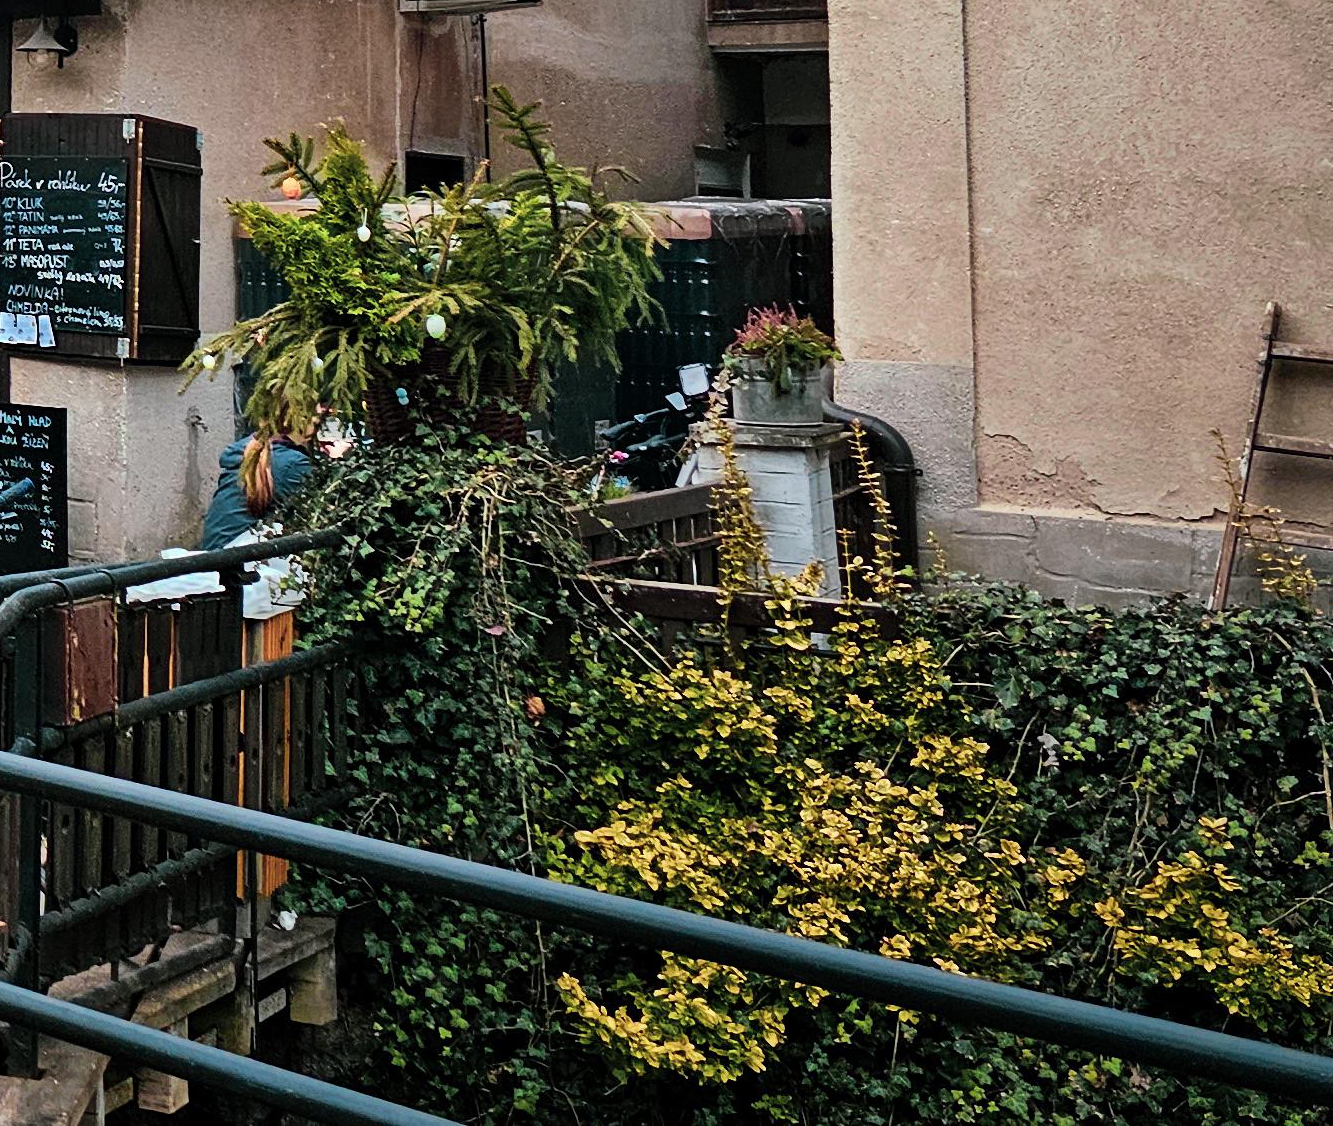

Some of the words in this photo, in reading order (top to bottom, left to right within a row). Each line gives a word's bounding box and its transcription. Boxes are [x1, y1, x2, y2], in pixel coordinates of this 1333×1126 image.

[0, 161, 33, 190] Párek
[35, 179, 44, 190] v
[47, 169, 91, 192] rohlíku
[17, 196, 44, 210] KLUK
[17, 210, 45, 222] TATIN
[17, 238, 44, 252] TETA
[20, 254, 70, 269] MASOPUST
[7, 283, 65, 301] NOVINKA!
